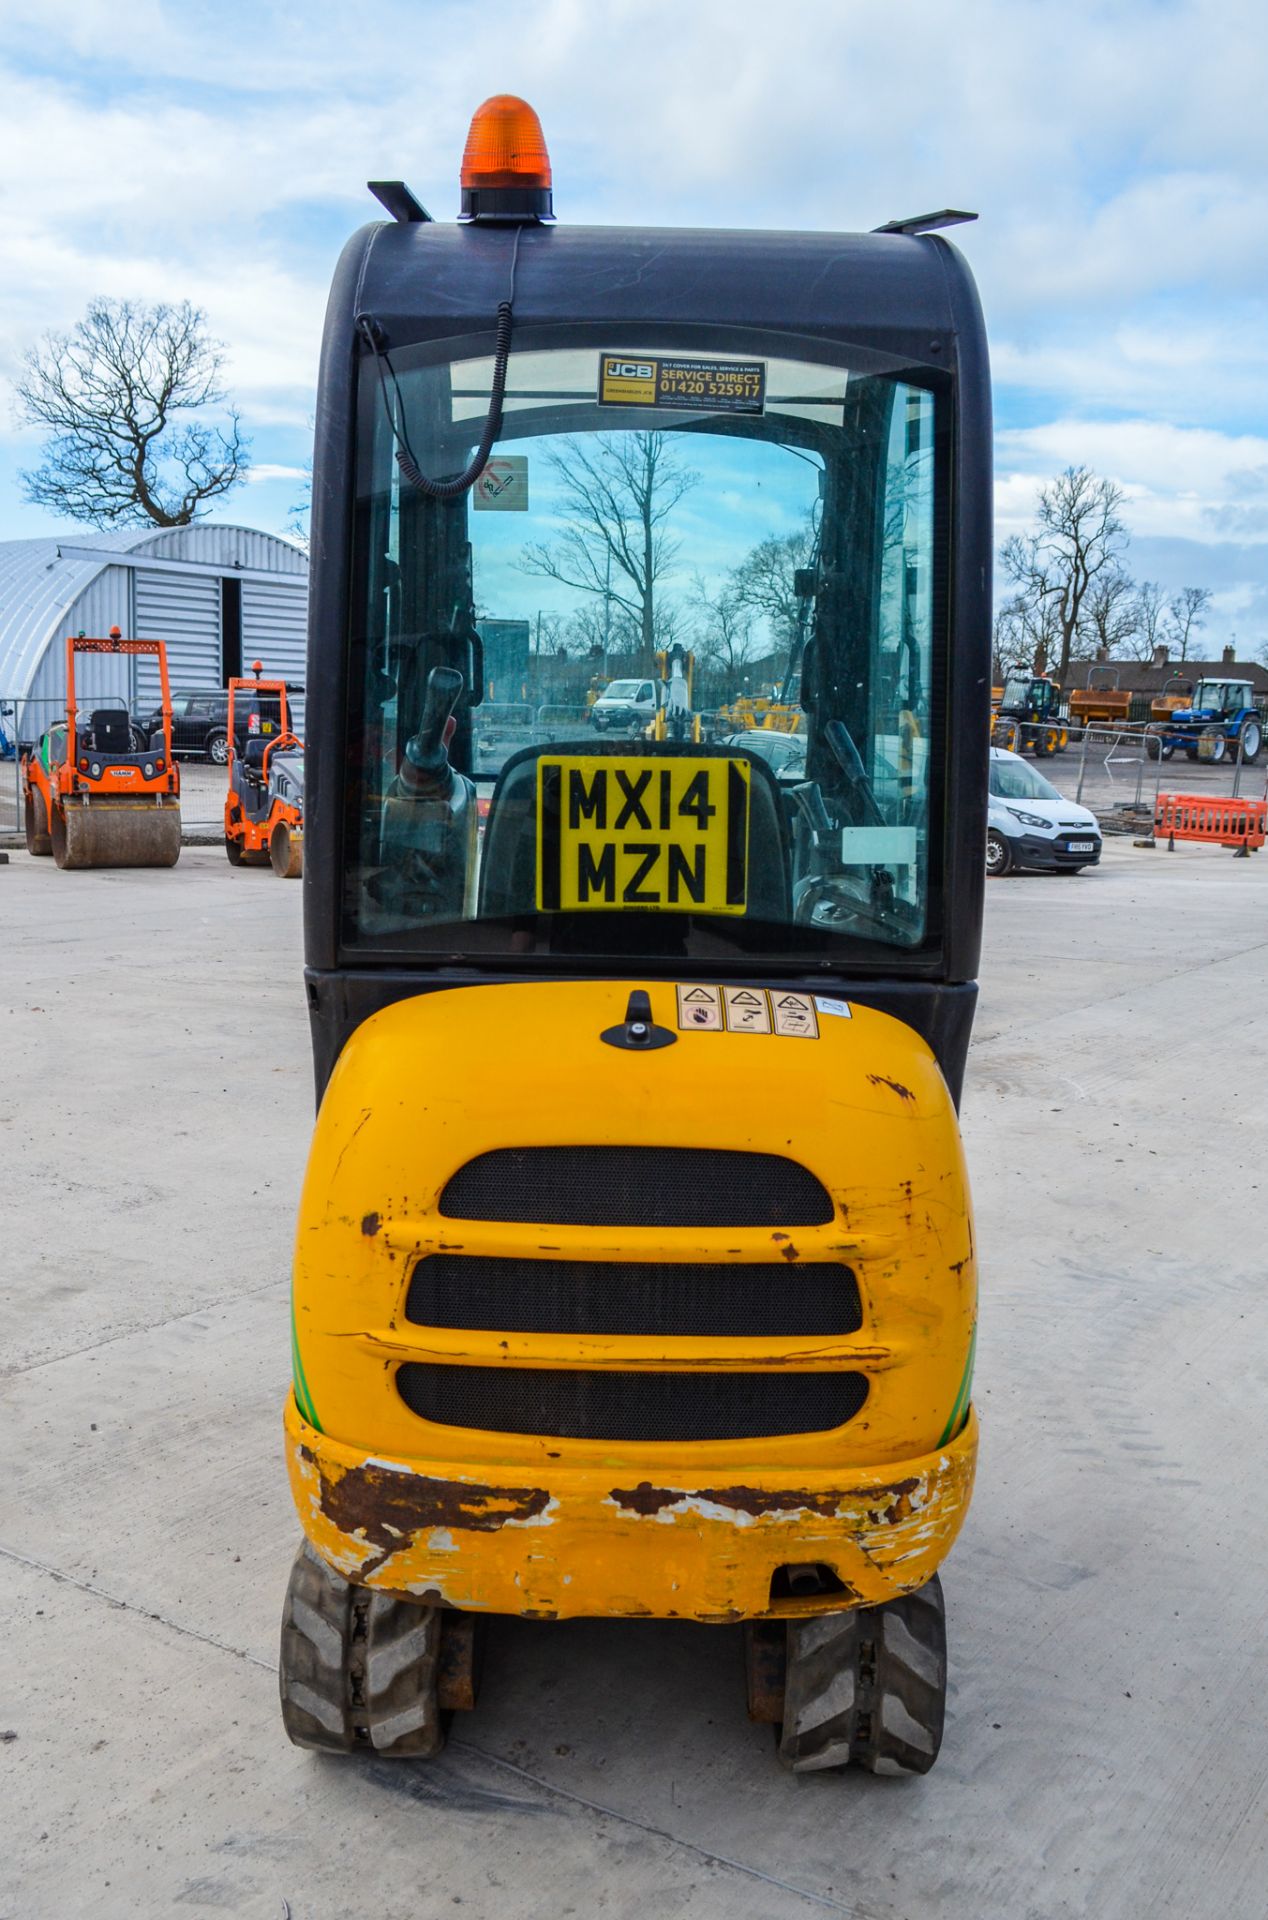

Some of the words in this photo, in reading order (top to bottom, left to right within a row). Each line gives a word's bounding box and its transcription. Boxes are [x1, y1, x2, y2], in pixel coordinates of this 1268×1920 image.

[607, 363, 652, 378] JCB
[661, 369, 713, 382] SERVICE
[715, 373, 760, 384] DIRECT
[660, 381, 705, 394] 01420
[708, 383, 760, 397] 525917
[568, 769, 716, 831] MX14
[578, 843, 706, 903] MZN
